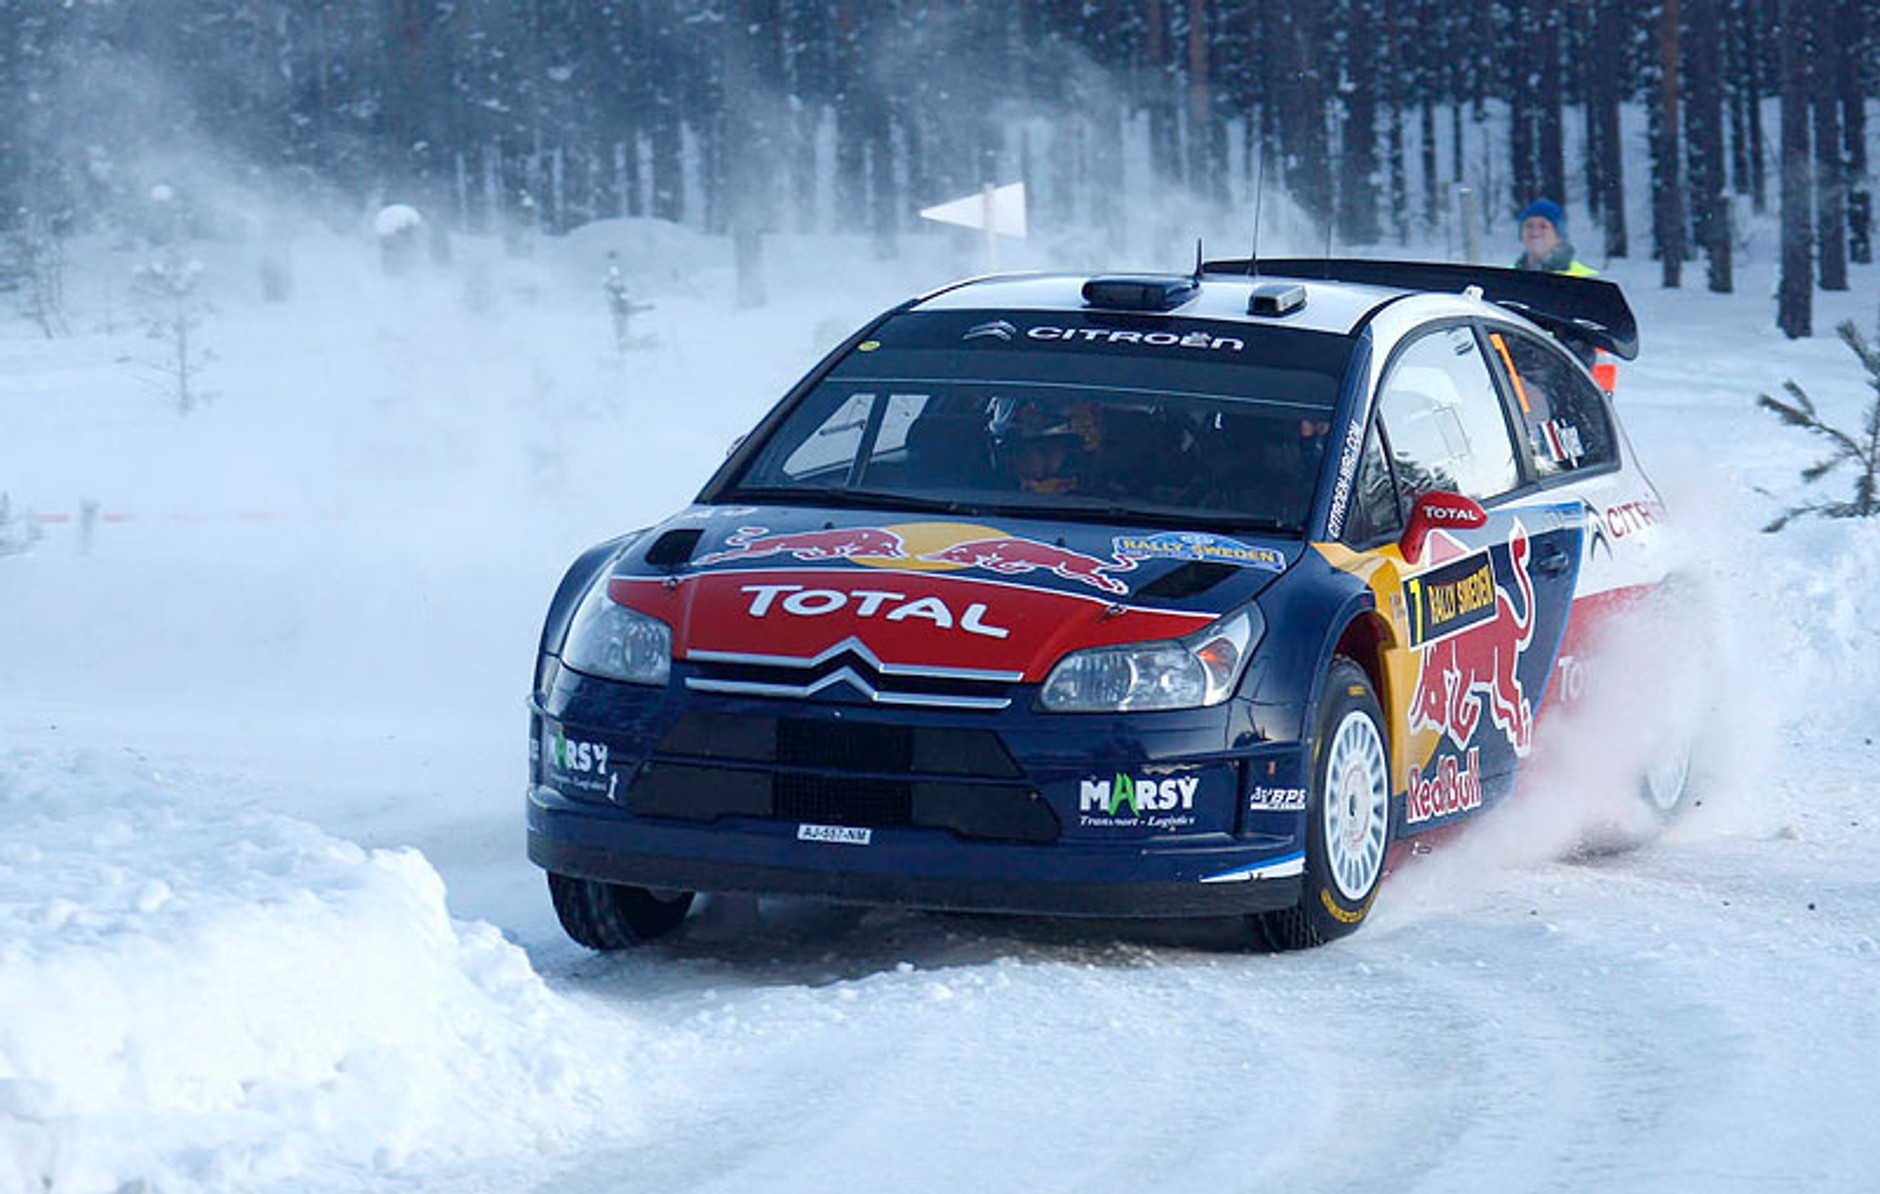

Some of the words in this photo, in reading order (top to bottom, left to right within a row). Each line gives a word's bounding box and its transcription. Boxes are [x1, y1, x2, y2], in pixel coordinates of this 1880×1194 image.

[1423, 505, 1478, 521] TOTAL
[1123, 539, 1184, 551] RALLY
[1191, 545, 1276, 564] SWEDEN
[740, 585, 1010, 639] TOTAL
[1426, 583, 1456, 625] RALLY
[1456, 564, 1493, 615] SWEDEN
[1080, 772, 1199, 817] MARSY
[1406, 754, 1446, 824] Red
[1446, 746, 1482, 814] Bull
